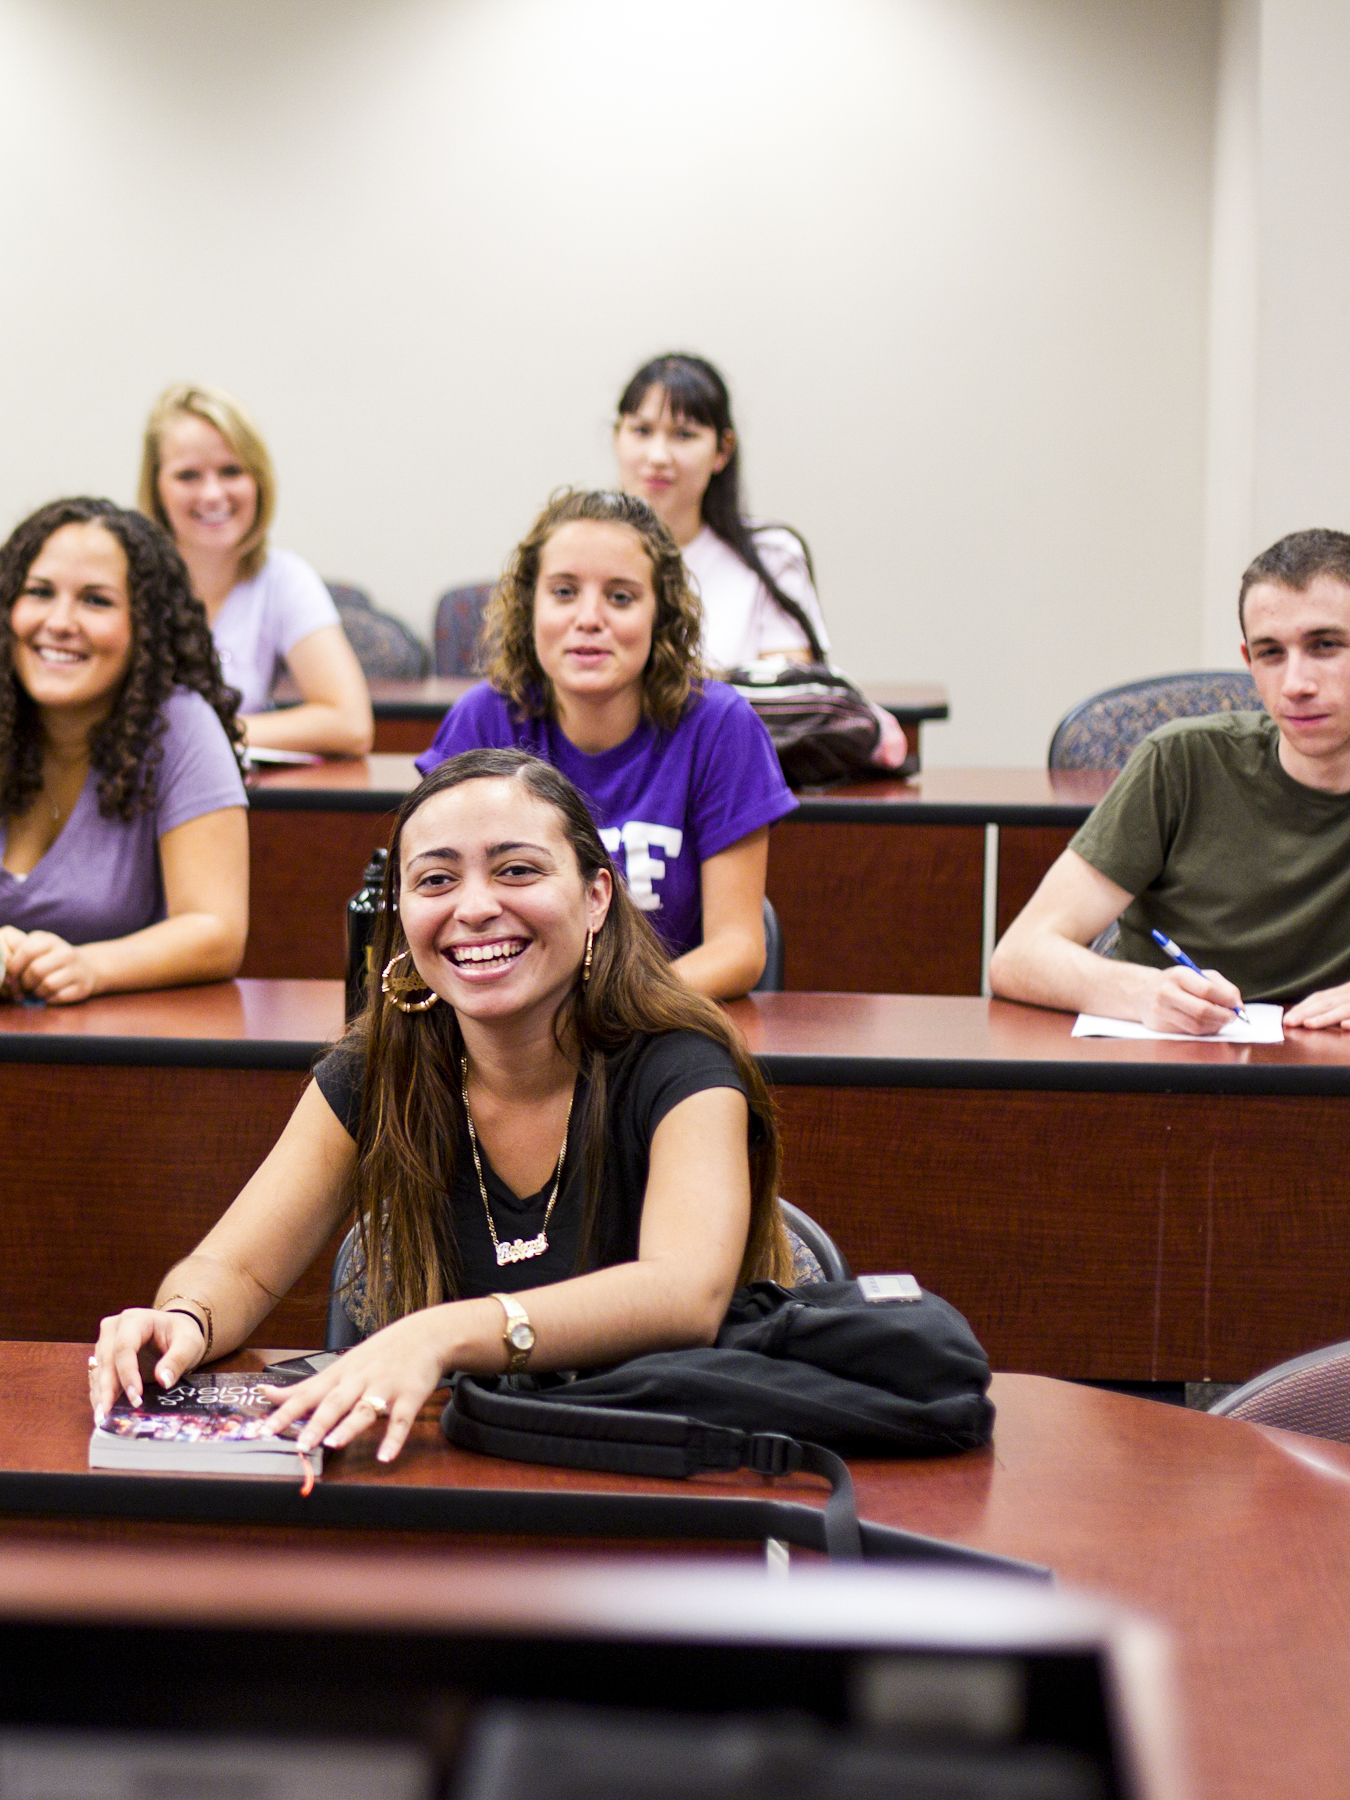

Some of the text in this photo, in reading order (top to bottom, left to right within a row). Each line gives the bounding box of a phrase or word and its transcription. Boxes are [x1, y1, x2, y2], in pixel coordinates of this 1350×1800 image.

[167, 1385, 263, 1397] ociety
[157, 1395, 272, 1406] olice &
